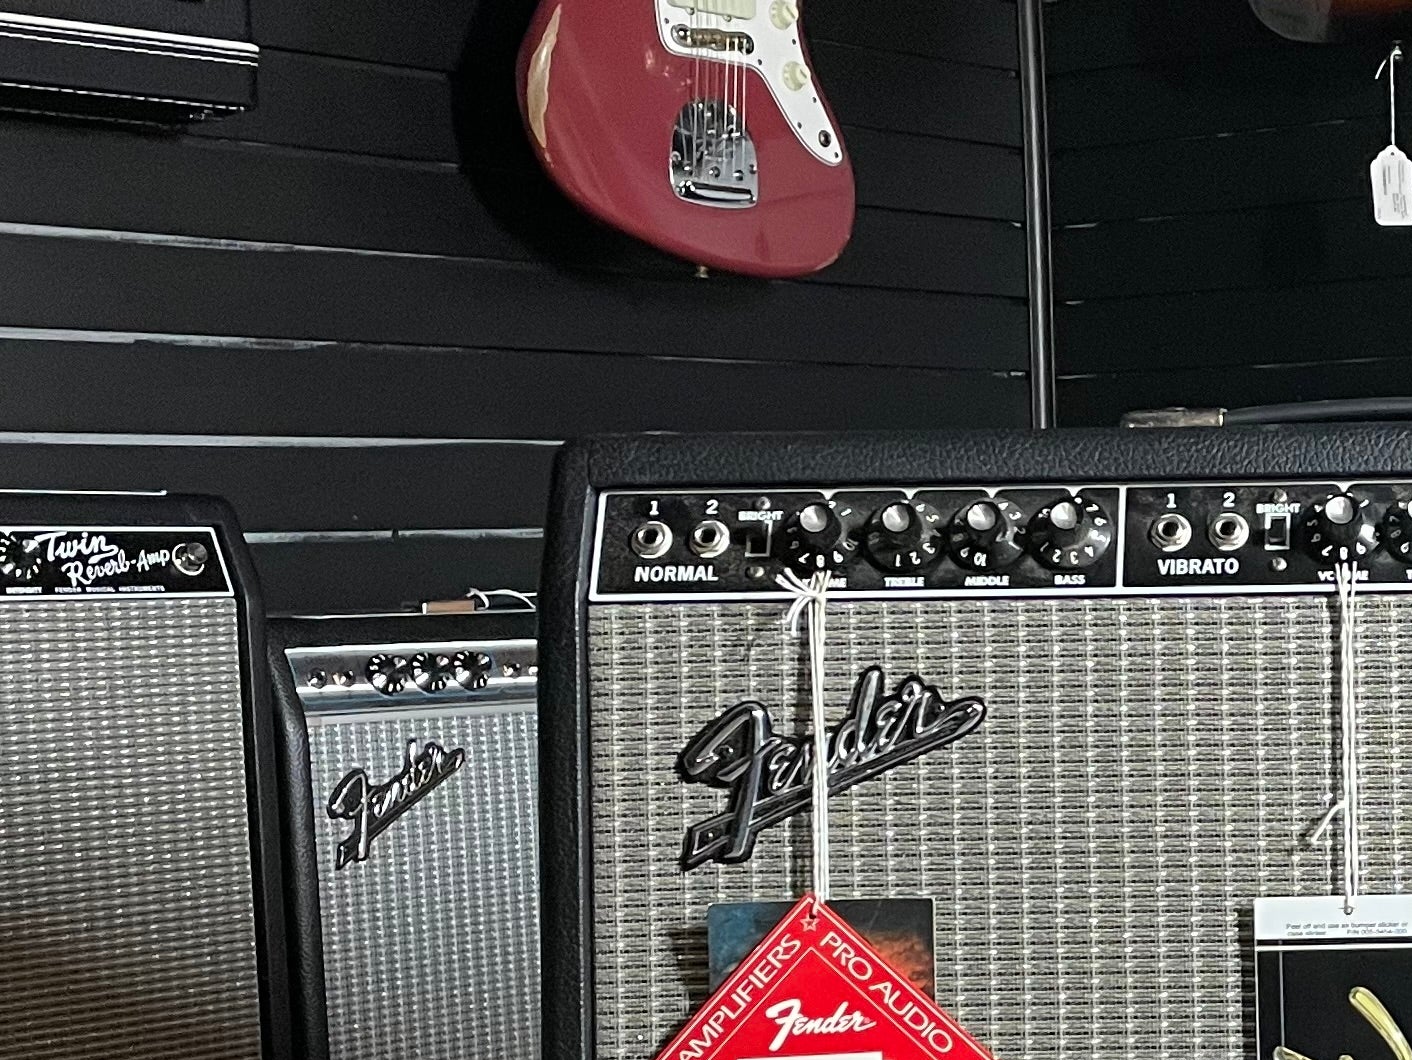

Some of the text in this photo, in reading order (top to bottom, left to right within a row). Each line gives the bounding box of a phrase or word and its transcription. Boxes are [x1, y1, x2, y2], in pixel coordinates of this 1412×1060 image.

[706, 499, 719, 515] 2
[1166, 493, 1176, 508] 1
[1223, 492, 1235, 507] 2
[650, 501, 659, 515] 1
[738, 510, 784, 521] BRIGHT
[1256, 503, 1301, 513] BRIGHT
[35, 531, 119, 563] Twin
[61, 549, 170, 586] Reverb-Amp
[634, 565, 719, 582] NORMAL
[1157, 557, 1240, 575] VIBRATO
[884, 577, 925, 587] TREBLE
[964, 575, 1010, 586] MIDDLE
[1054, 574, 1086, 585] BASS
[674, 665, 987, 871] Fender
[327, 739, 465, 870] Fender
[820, 931, 954, 1054] PRO AUDIO
[766, 998, 877, 1052] Fender
